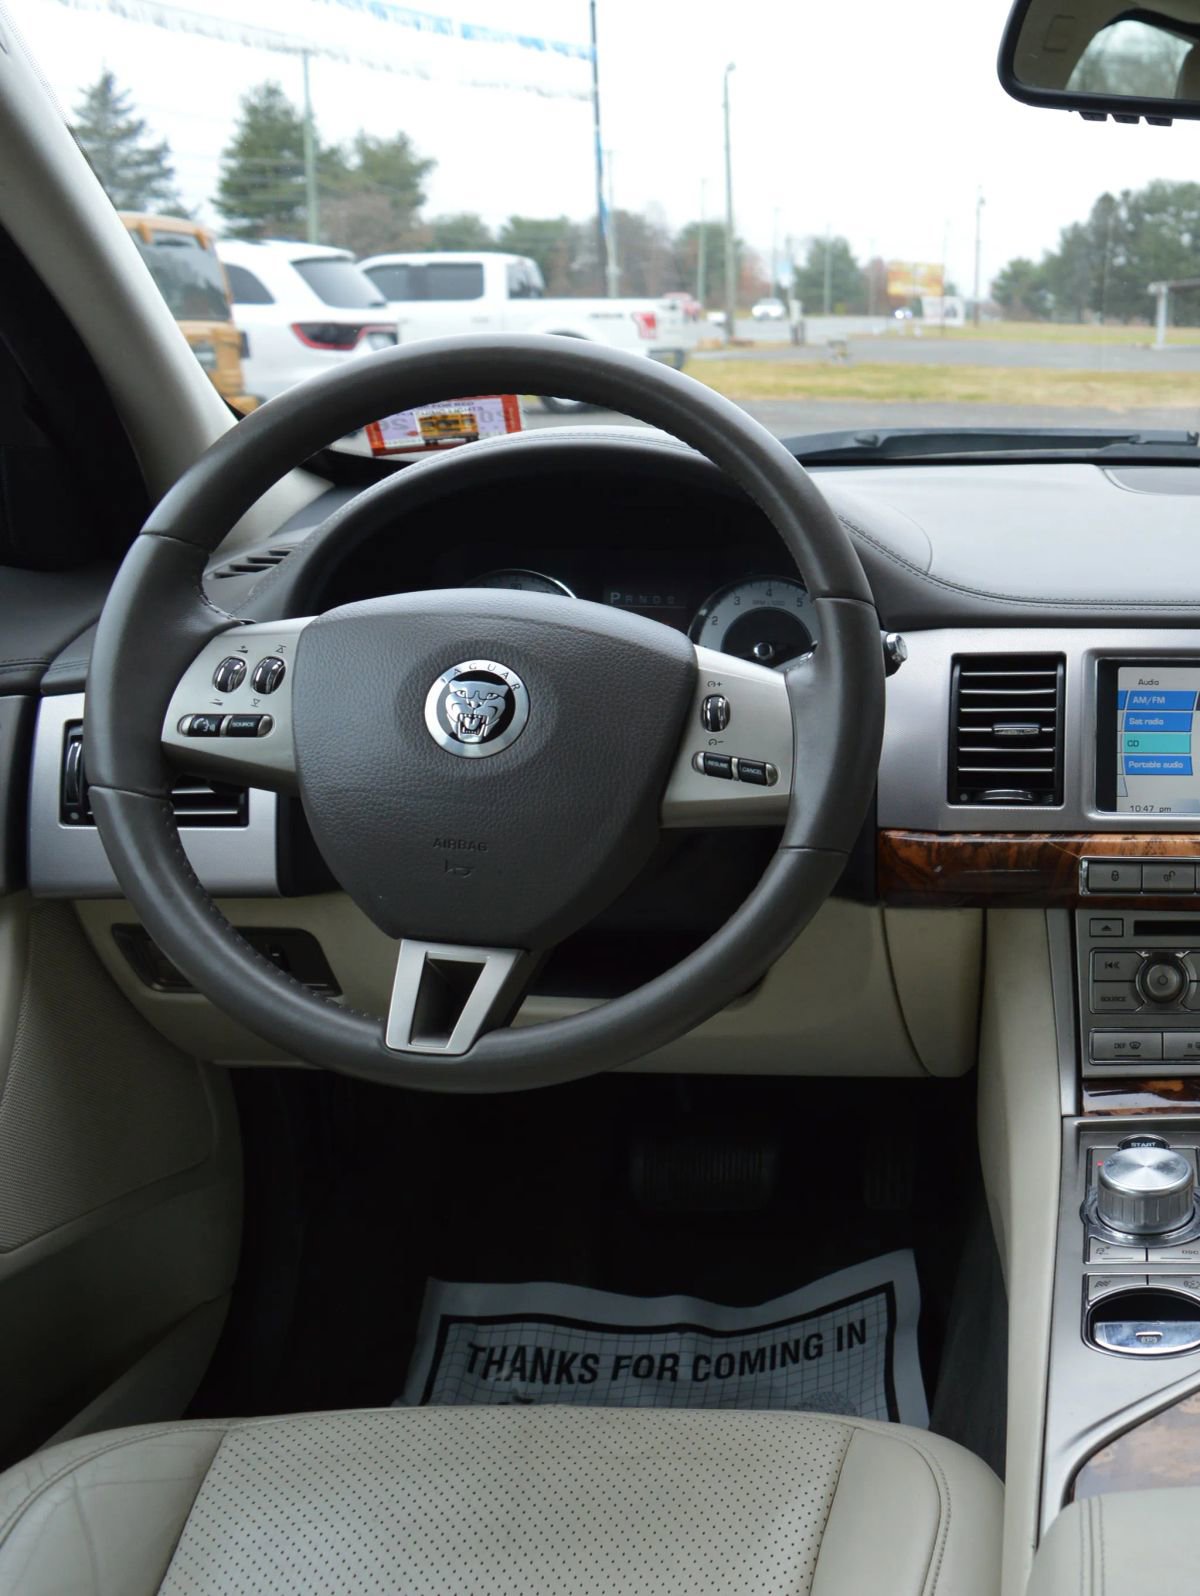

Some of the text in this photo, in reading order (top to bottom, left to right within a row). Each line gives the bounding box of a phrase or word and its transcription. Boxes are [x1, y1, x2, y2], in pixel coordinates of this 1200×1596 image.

[766, 588, 773, 597] 4
[734, 596, 741, 606] 3
[796, 597, 803, 607] 5
[711, 616, 719, 626] 2
[440, 663, 522, 692] JAGUAR
[1133, 696, 1166, 705] AM/FM
[433, 838, 488, 851] AIRBAG
[466, 1318, 867, 1385] THANKS FOR COMING IN
